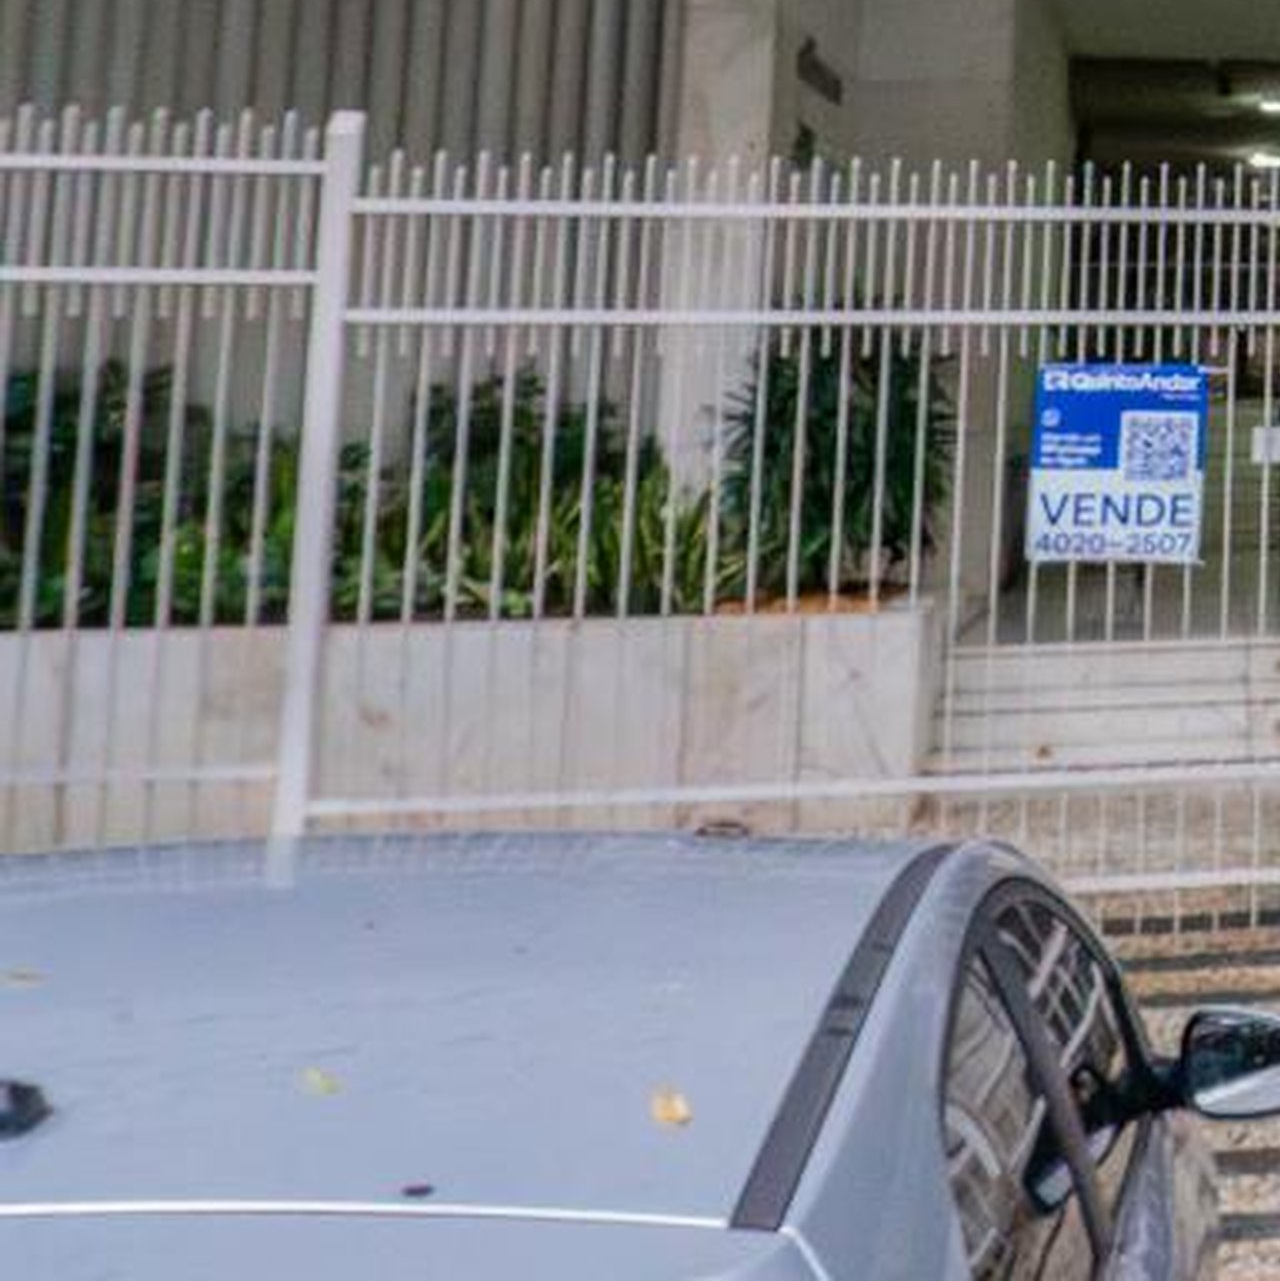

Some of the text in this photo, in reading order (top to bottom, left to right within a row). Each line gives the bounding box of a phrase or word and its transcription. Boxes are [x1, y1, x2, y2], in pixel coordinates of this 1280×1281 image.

[1070, 371, 1200, 391] QuintoAndar
[1040, 493, 1193, 527] VENDE
[1035, 532, 1192, 555] 4020-2507
